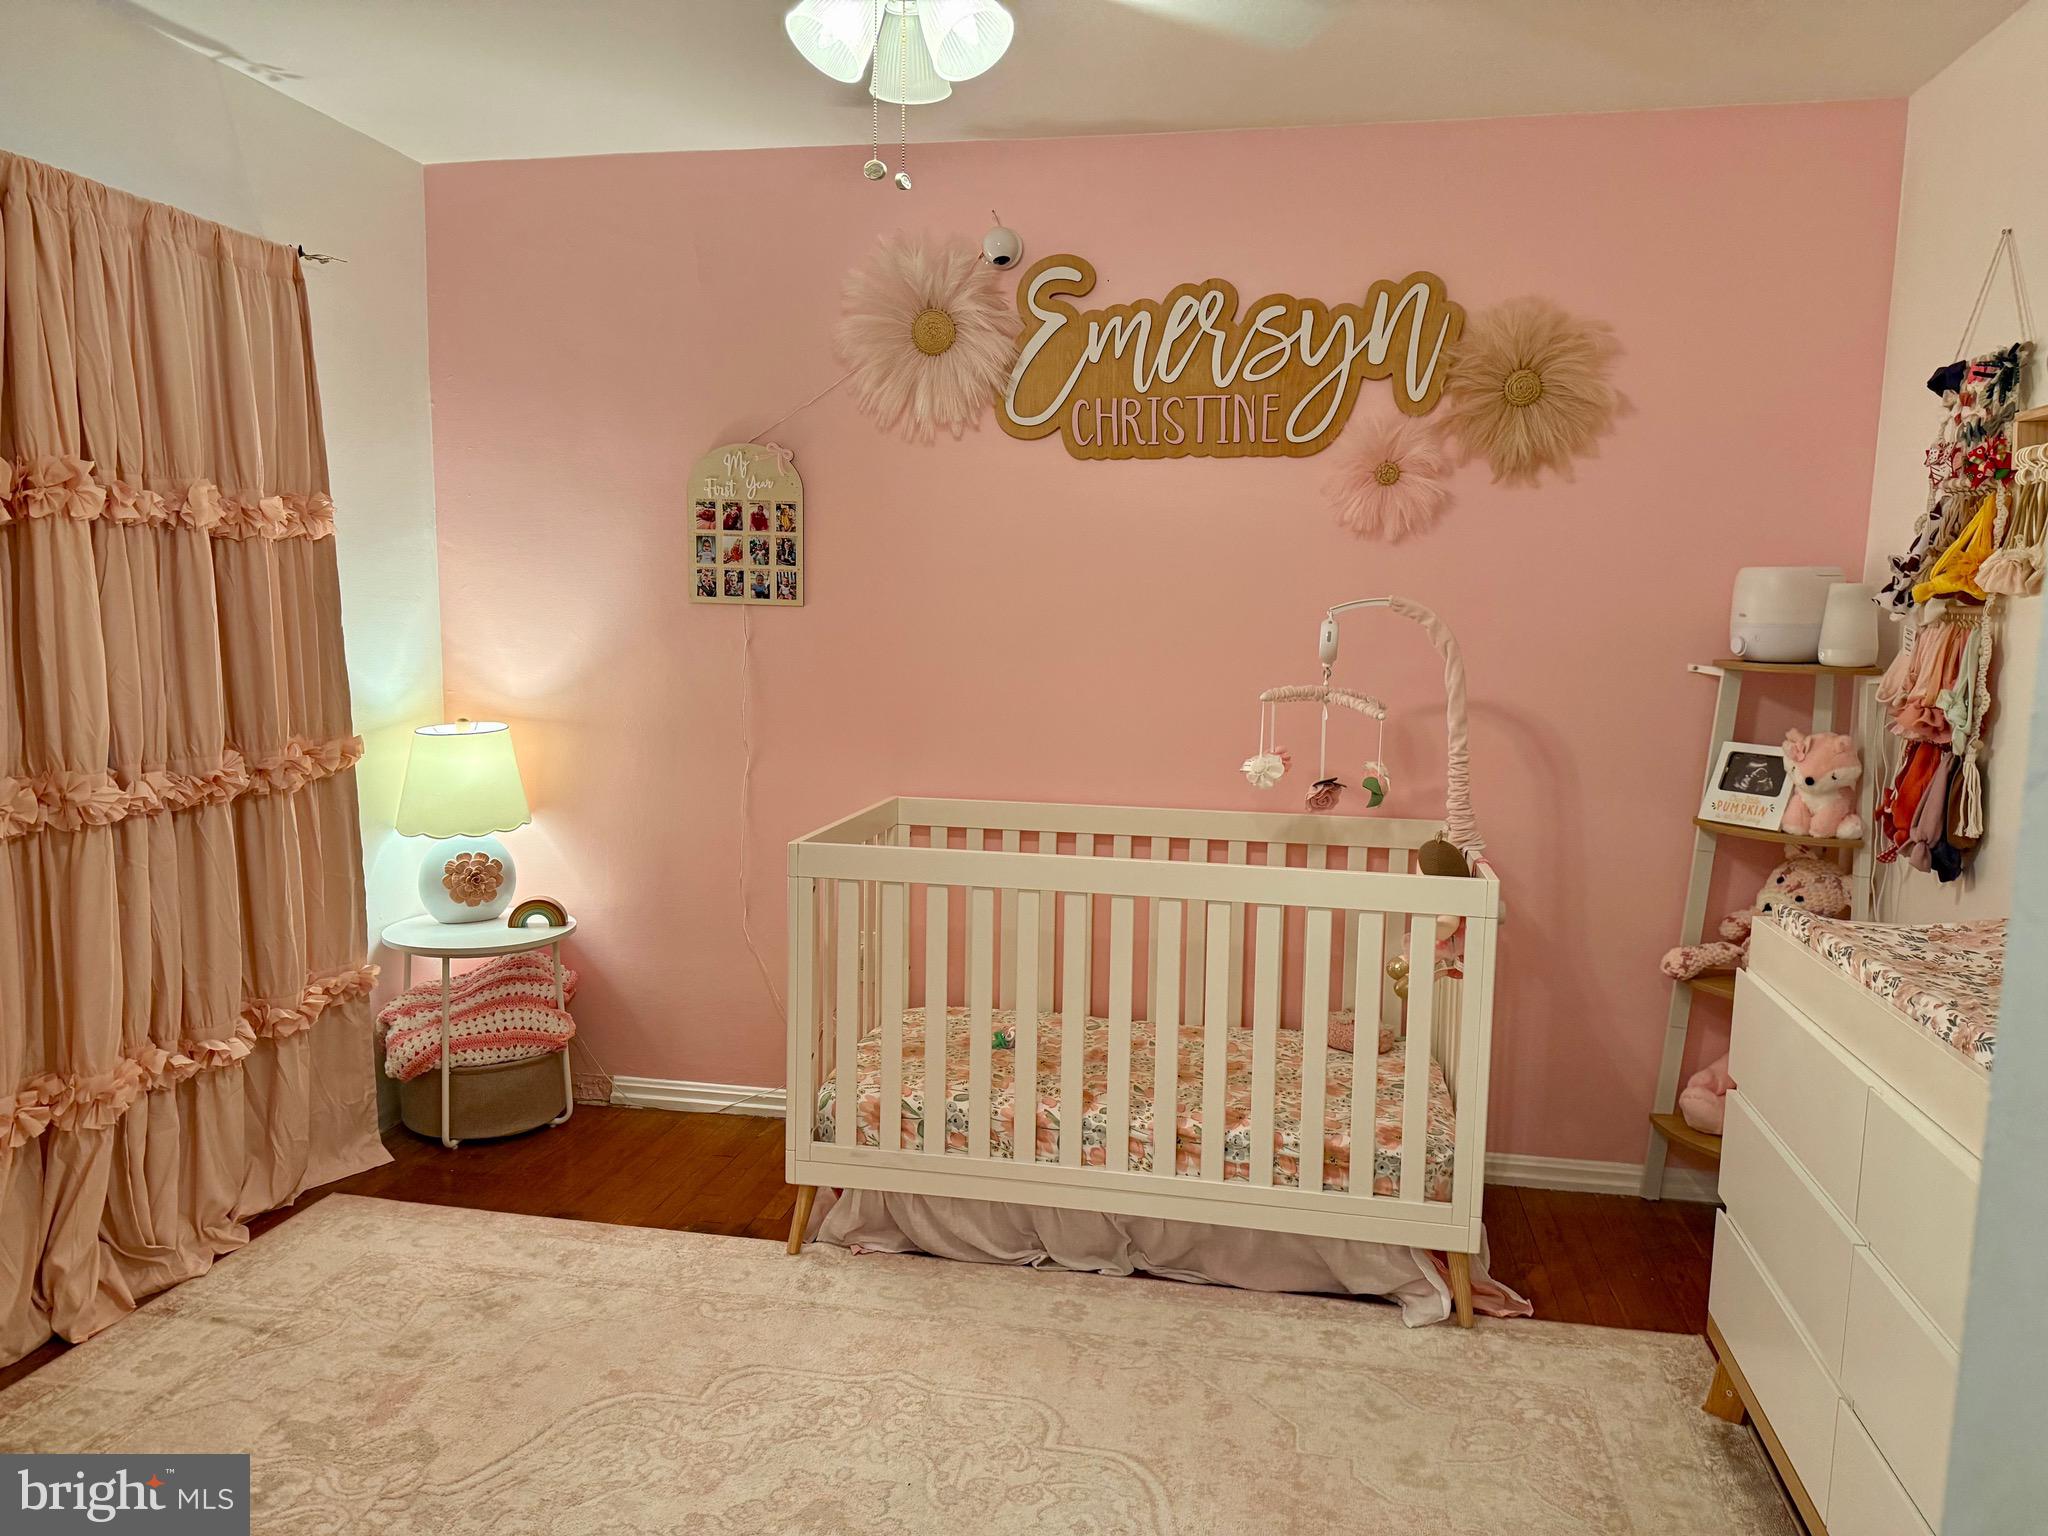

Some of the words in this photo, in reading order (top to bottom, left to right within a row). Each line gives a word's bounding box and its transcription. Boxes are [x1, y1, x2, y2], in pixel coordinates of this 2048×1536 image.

[1004, 265, 1451, 443] Emersyn
[1071, 393, 1280, 446] CHRISTINE
[723, 450, 750, 478] My
[704, 477, 737, 498] First
[745, 474, 774, 499] Year
[1716, 799, 1769, 817] PUMPKIN
